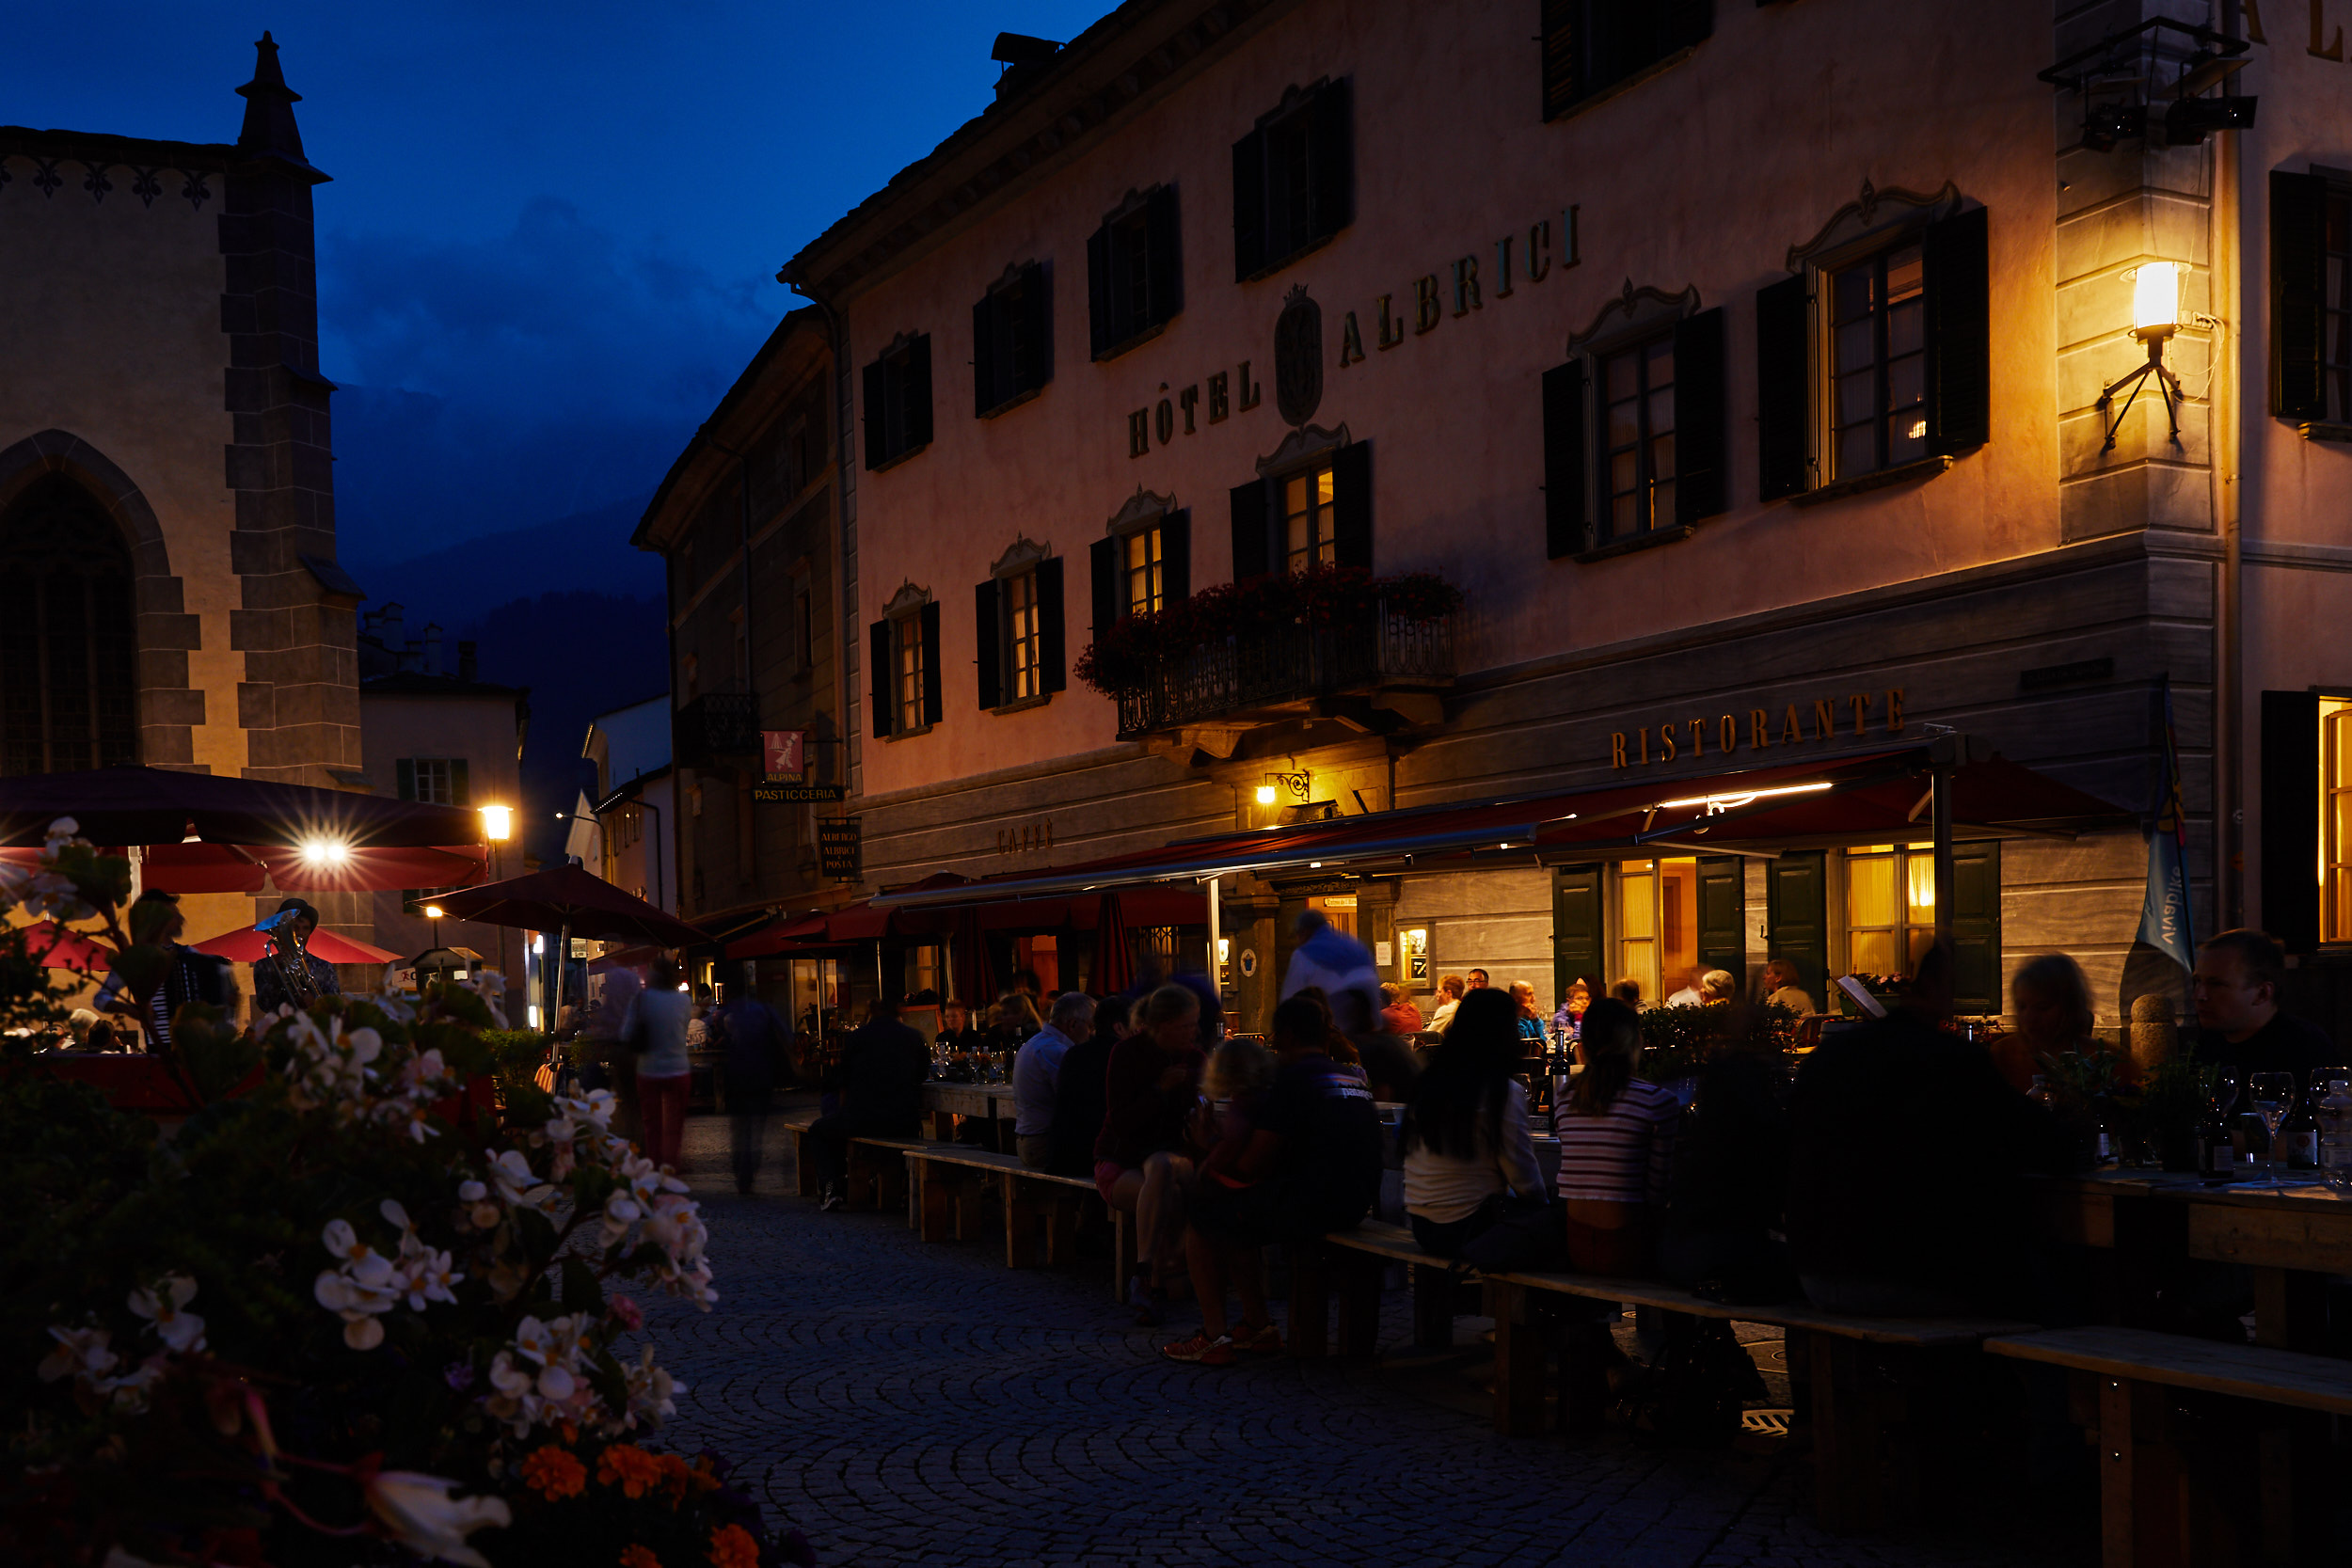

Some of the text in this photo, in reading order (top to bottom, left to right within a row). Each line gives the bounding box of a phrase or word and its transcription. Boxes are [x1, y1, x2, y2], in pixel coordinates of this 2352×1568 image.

[1128, 203, 1581, 459] HÔTEL ALBRICI
[1610, 688, 1906, 770] RISTORANTE
[767, 772, 803, 783] ALPINA
[755, 789, 836, 801] PASTICCERIA
[820, 832, 858, 842] ALBERGO
[823, 846, 855, 855] ALBRICI
[826, 860, 853, 869] POSTA
